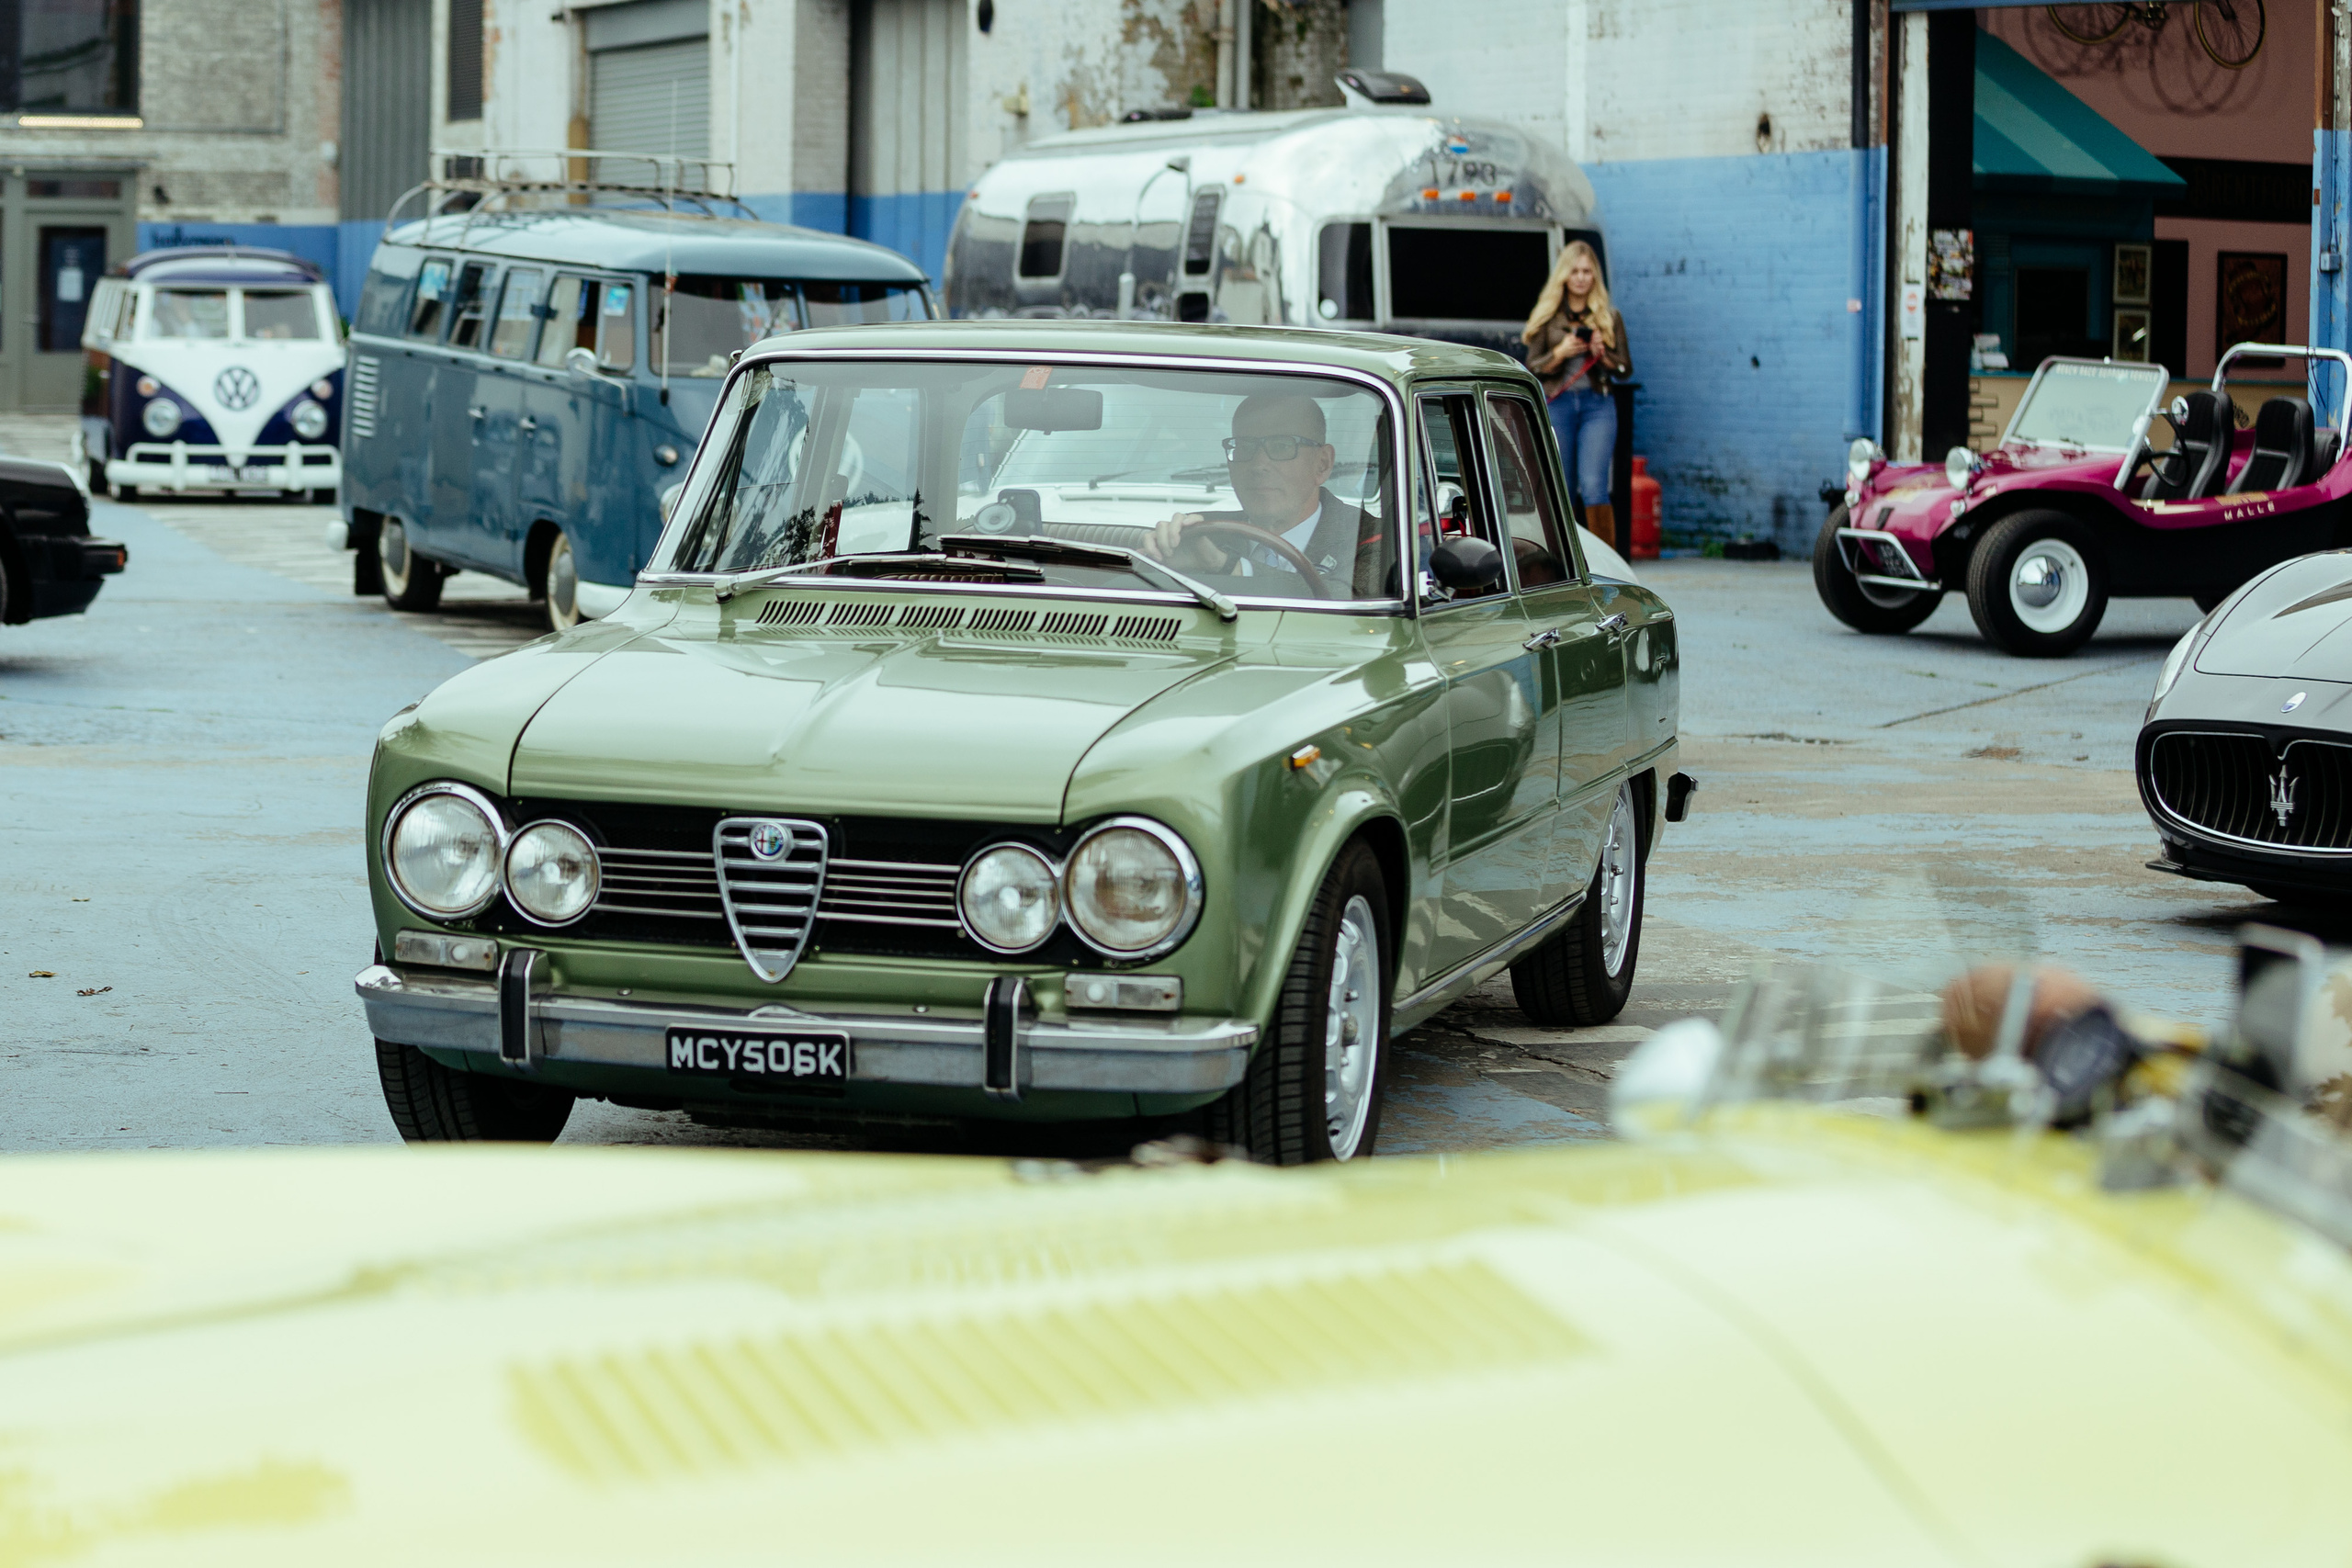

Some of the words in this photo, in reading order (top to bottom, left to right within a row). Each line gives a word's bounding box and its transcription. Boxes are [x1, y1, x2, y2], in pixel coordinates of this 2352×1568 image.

[2189, 165, 2310, 209] BRENTFORD
[2224, 501, 2276, 521] MALLE
[671, 1036, 842, 1077] MCY506K
